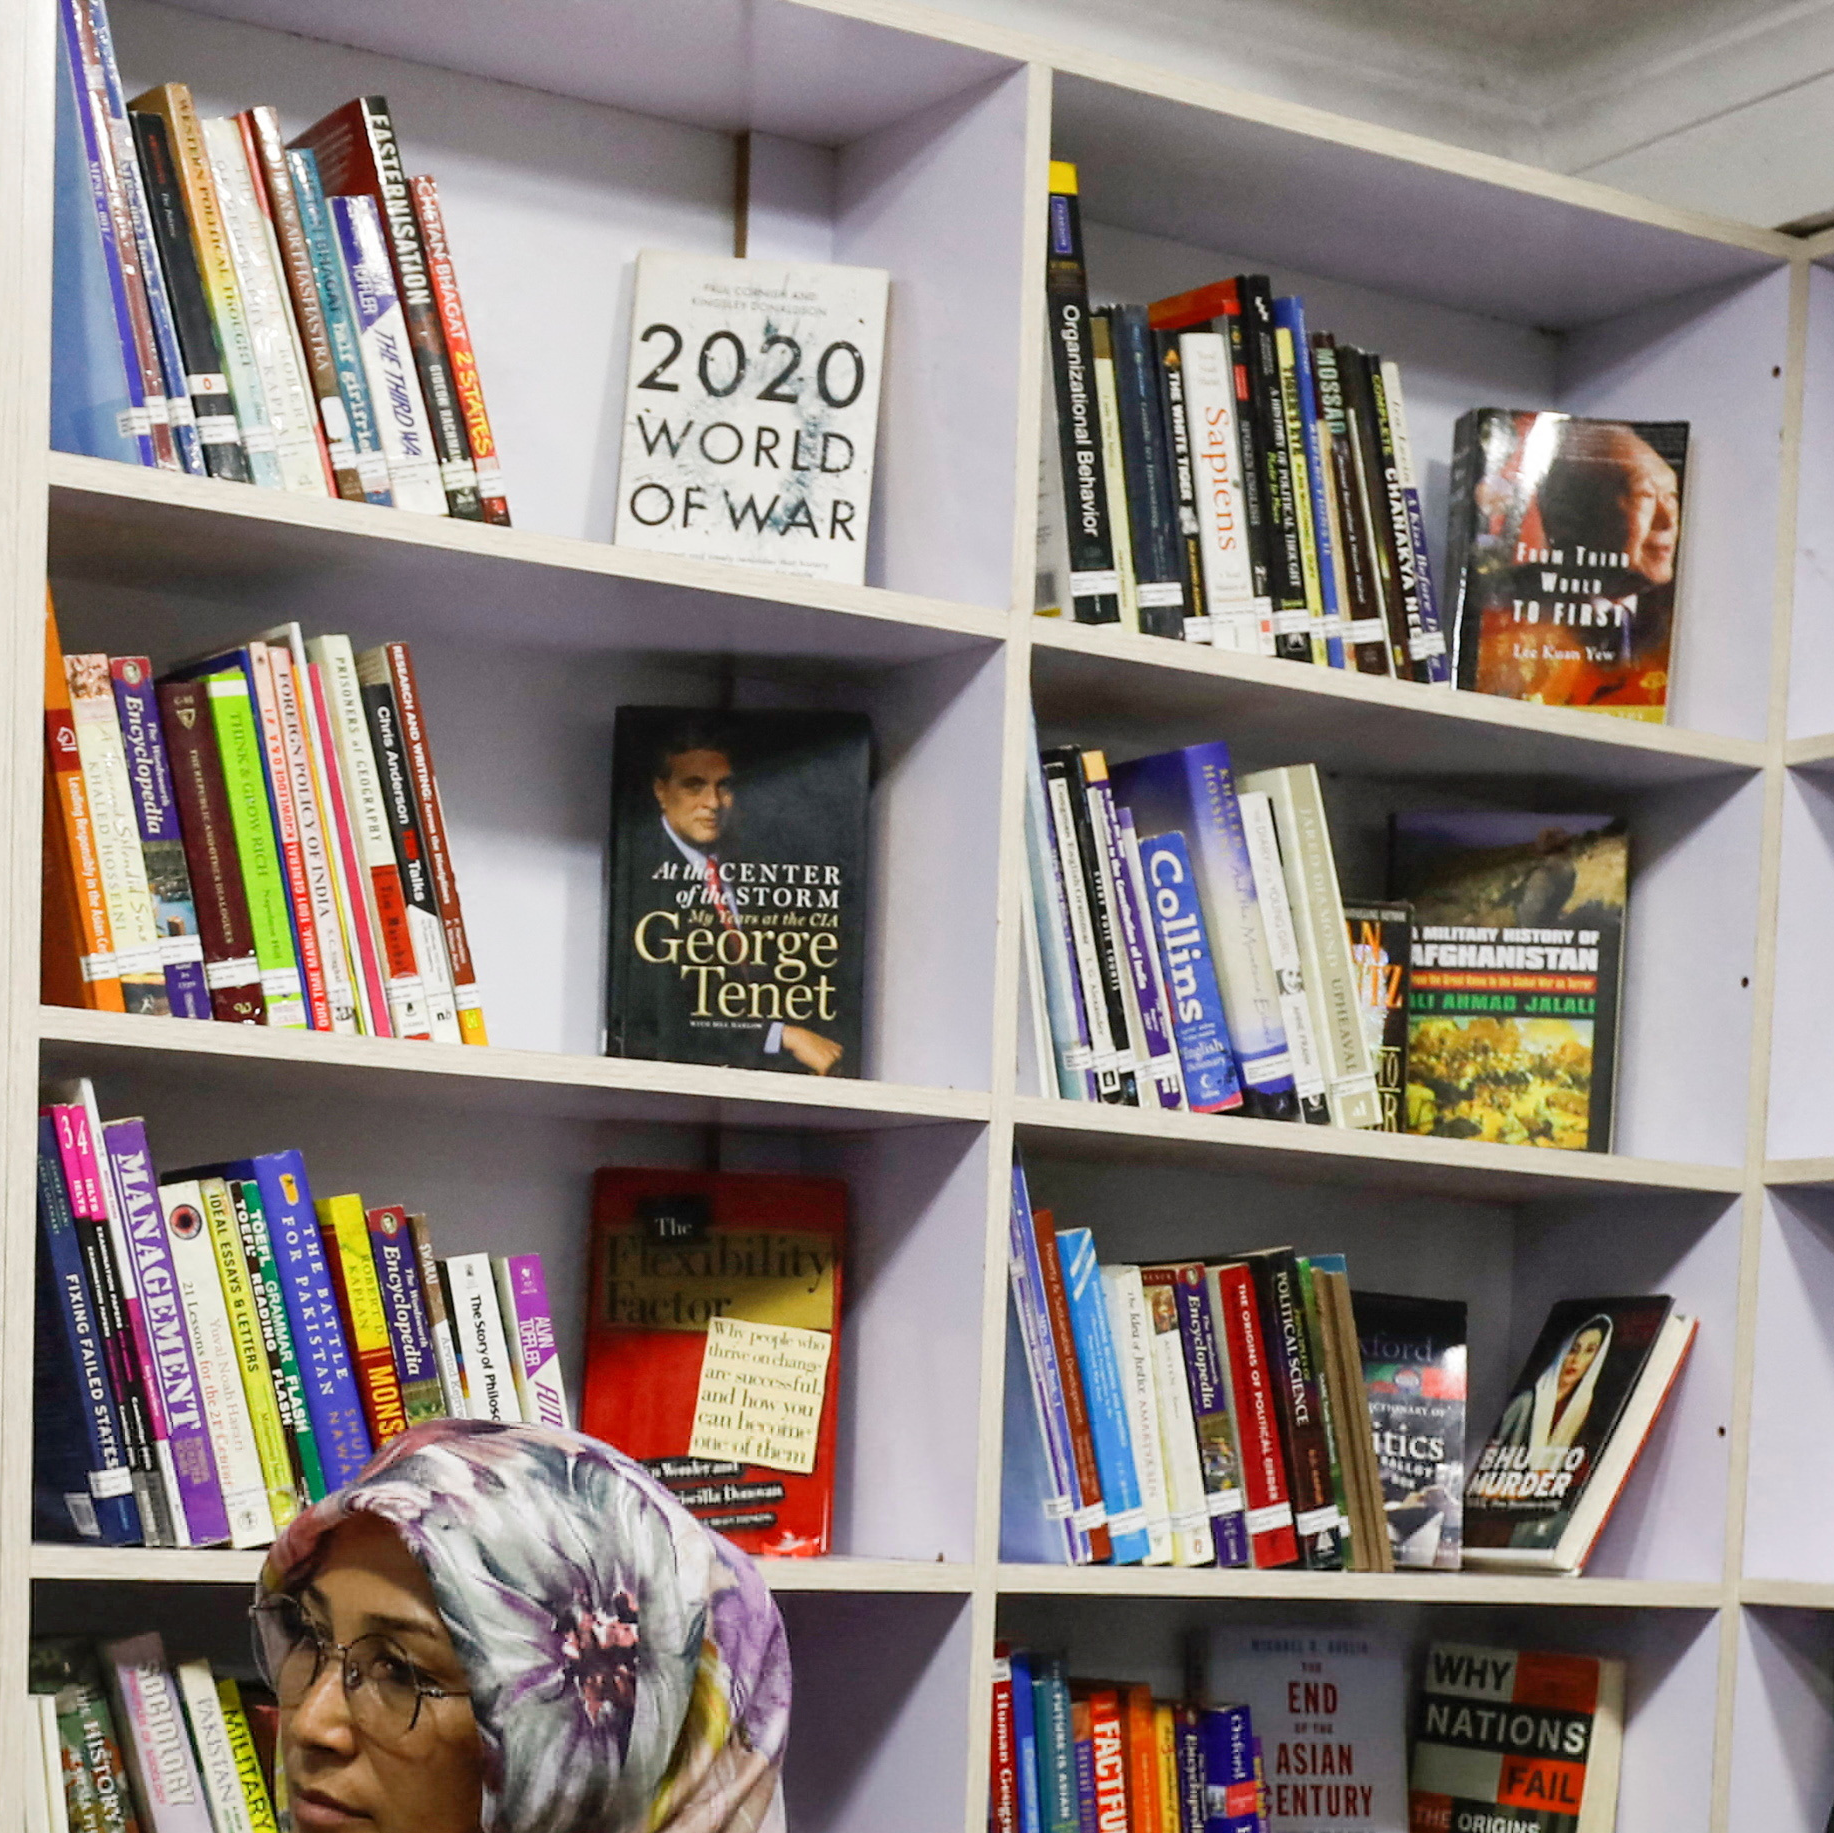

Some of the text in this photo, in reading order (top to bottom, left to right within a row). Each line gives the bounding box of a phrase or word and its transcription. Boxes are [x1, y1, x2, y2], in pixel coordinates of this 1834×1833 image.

[179, 98, 249, 368] WESTERN POLITICAL THOUGHT
[368, 110, 431, 306] EASTERNISATION
[418, 179, 489, 455] CHETAN BHAGAT 2 STATES
[637, 323, 865, 408] 2020
[1315, 346, 1346, 435] MOSSAD
[638, 415, 854, 473] WORLD
[1060, 304, 1099, 536] Organizational Behavior
[1167, 372, 1193, 500] THE WHITE TIGER
[630, 483, 856, 541] OF WAR
[1199, 403, 1239, 548] Sapiens
[1513, 600, 1623, 627] TO FIRST
[122, 693, 163, 834] Encyclopedia
[336, 655, 359, 732] PRISONERS
[356, 758, 381, 843] GEOGRAPHY
[376, 704, 396, 748] Chris
[230, 711, 248, 759] THINK
[243, 781, 260, 831] GROW
[252, 834, 267, 875] RICH
[278, 672, 329, 915] FOREIGN POLICY OF INDIA
[384, 748, 409, 825] Anderson
[408, 861, 426, 902] Talks
[653, 861, 842, 885] At the CENTER
[676, 884, 839, 909] of the STORM
[635, 911, 838, 982] George
[687, 909, 839, 928] My Years at the CIA
[1149, 847, 1209, 1024] Collins
[1412, 943, 1599, 971] AFGHANISTAN
[1423, 927, 1599, 945] MILITARY HISTORY OF
[680, 965, 836, 1021] Tenet
[1330, 976, 1355, 1069] UPHEAVAL
[1442, 994, 1596, 1014] AHMAD JALALI
[606, 1233, 833, 1293] Flexibility
[655, 1217, 692, 1236] The
[117, 1147, 198, 1432] MANAGEMENT
[210, 1192, 228, 1234] IDEAL
[221, 1241, 241, 1293] ESSAYS
[237, 1311, 258, 1372] LETTERS
[249, 1207, 307, 1431] TOEFL GRAMMAR FLASH
[282, 1215, 333, 1395] FOR PAKISTAN
[303, 1223, 347, 1380] THE BATTLE
[382, 1244, 420, 1374] Encyclopedia
[605, 1280, 732, 1325] Factor
[66, 1272, 118, 1469] FIXING FAILED STATES
[252, 1271, 275, 1350] READING
[272, 1366, 290, 1422] FLASH
[1236, 1283, 1271, 1455] THE ORIGINS OF POLITICAL
[1275, 1271, 1307, 1425] POLITICAL SCIENCE
[1468, 1471, 1571, 1498] MURDER
[1288, 1681, 1338, 1714] END
[1434, 1653, 1511, 1691] WHY
[220, 1707, 272, 1828] MILITARY
[995, 1691, 1013, 1763] Human
[1277, 1743, 1352, 1776] ASIAN
[1426, 1705, 1588, 1755] NATIONS
[1505, 1766, 1577, 1805] FAIL
